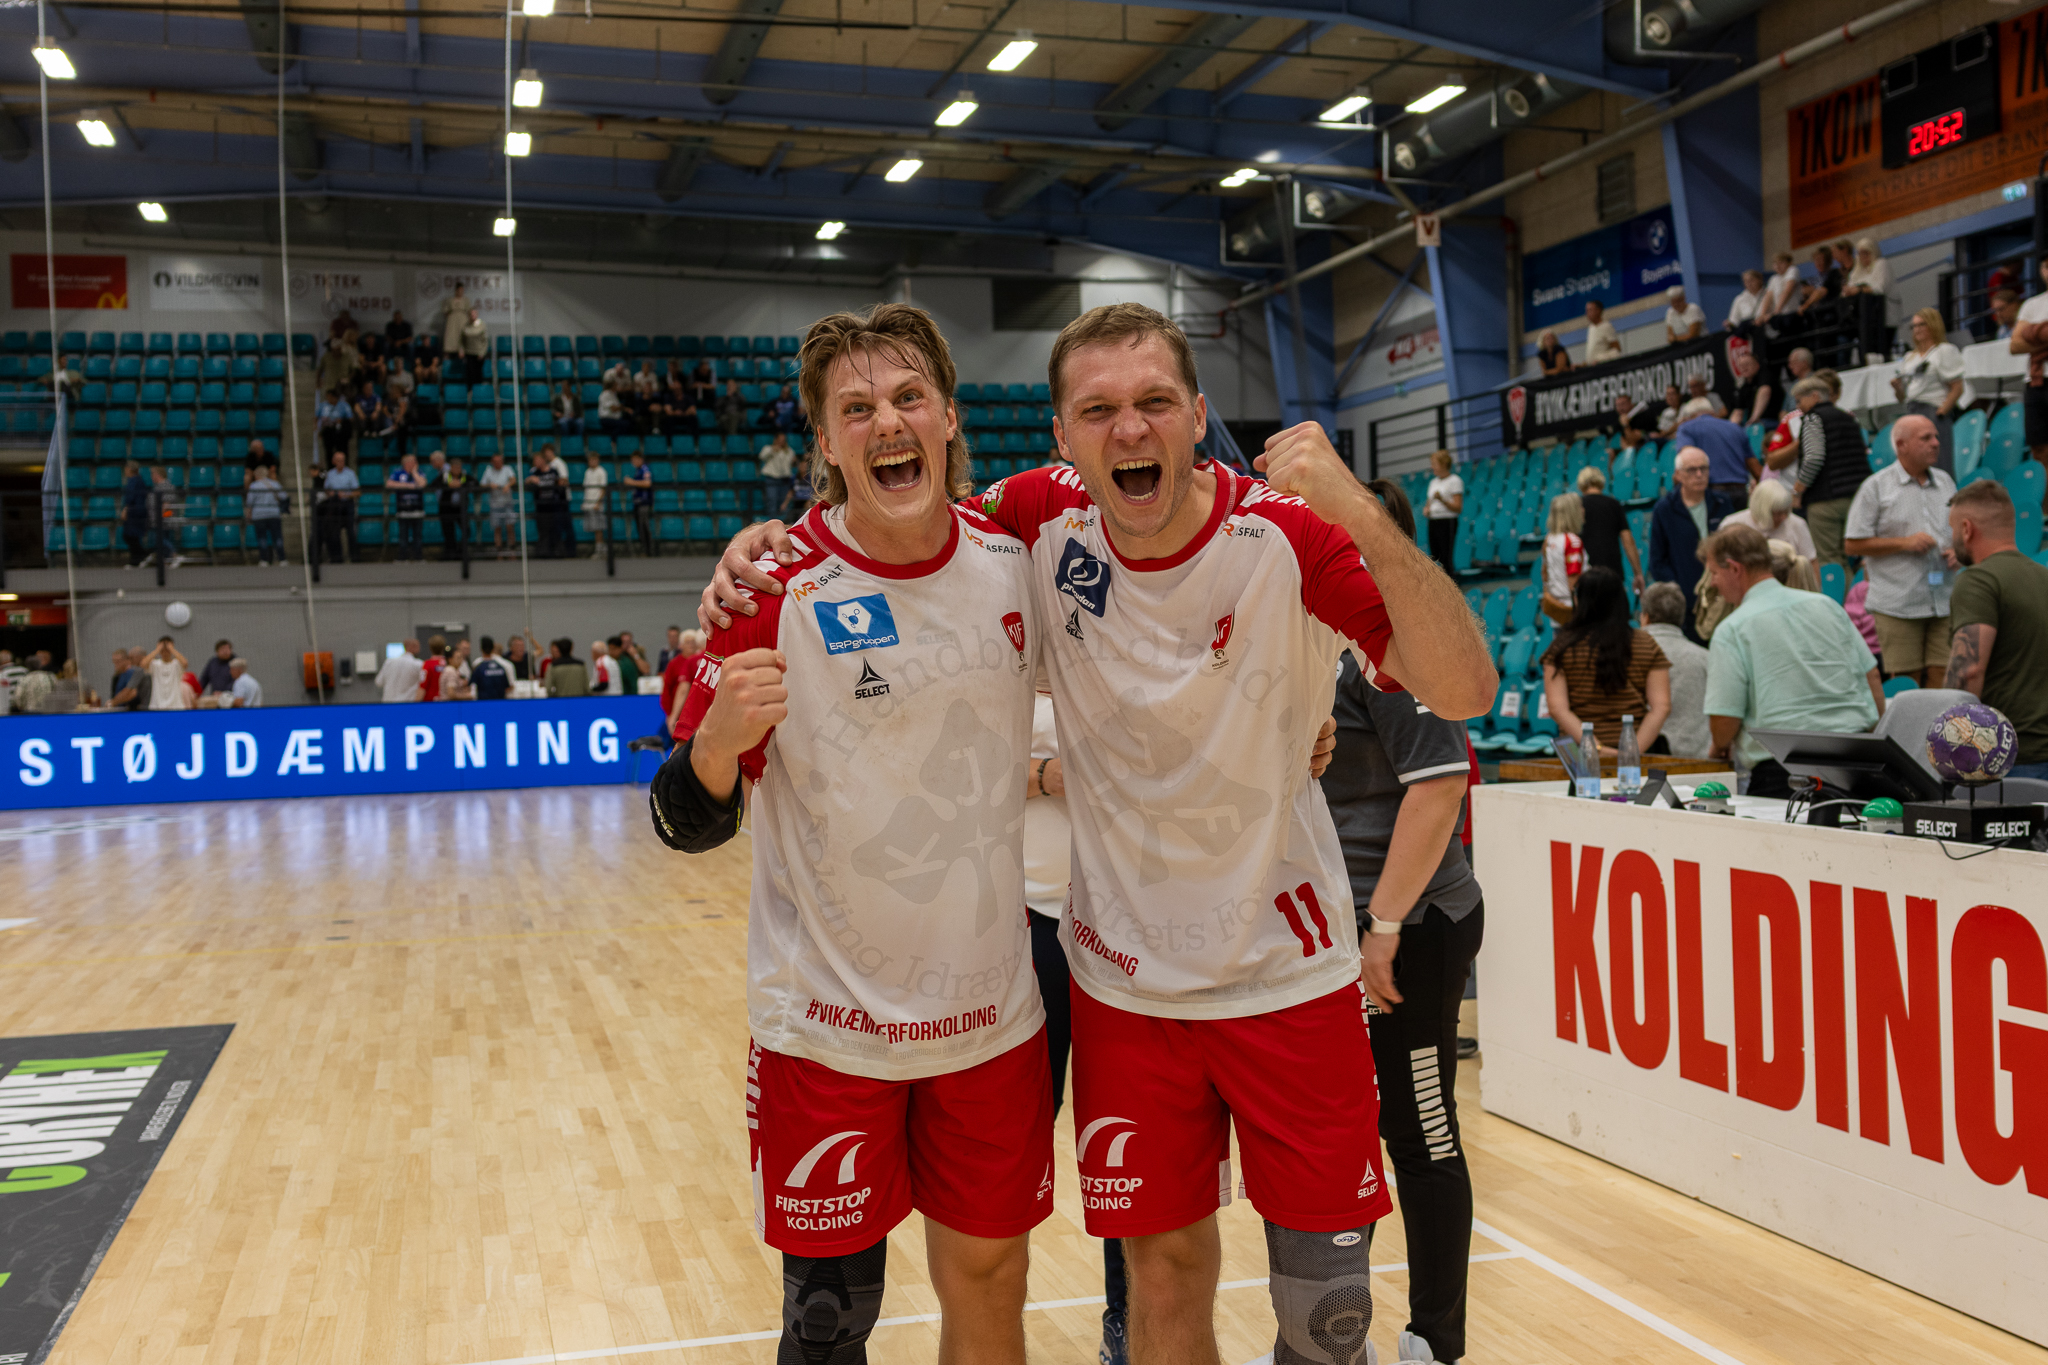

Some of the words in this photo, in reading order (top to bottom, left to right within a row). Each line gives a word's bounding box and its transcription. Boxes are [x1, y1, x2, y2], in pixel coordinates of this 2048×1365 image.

[1908, 110, 1963, 156] 20:52
[1421, 219, 1434, 237] V
[348, 296, 392, 311] NORD
[1236, 527, 1266, 538] SFALT
[986, 543, 1023, 556] ASFALT
[854, 683, 891, 700] SELECT
[18, 717, 621, 787] STØJDÆMPNING
[1988, 723, 2013, 774] SELECT
[1916, 818, 1958, 838] SELECT
[1985, 820, 2031, 839] SELECT
[1273, 881, 1334, 958] 11
[1550, 840, 2048, 1200] KOLDING
[775, 1187, 872, 1215] FIRSTSTOP
[786, 1210, 864, 1231] KOLDING
